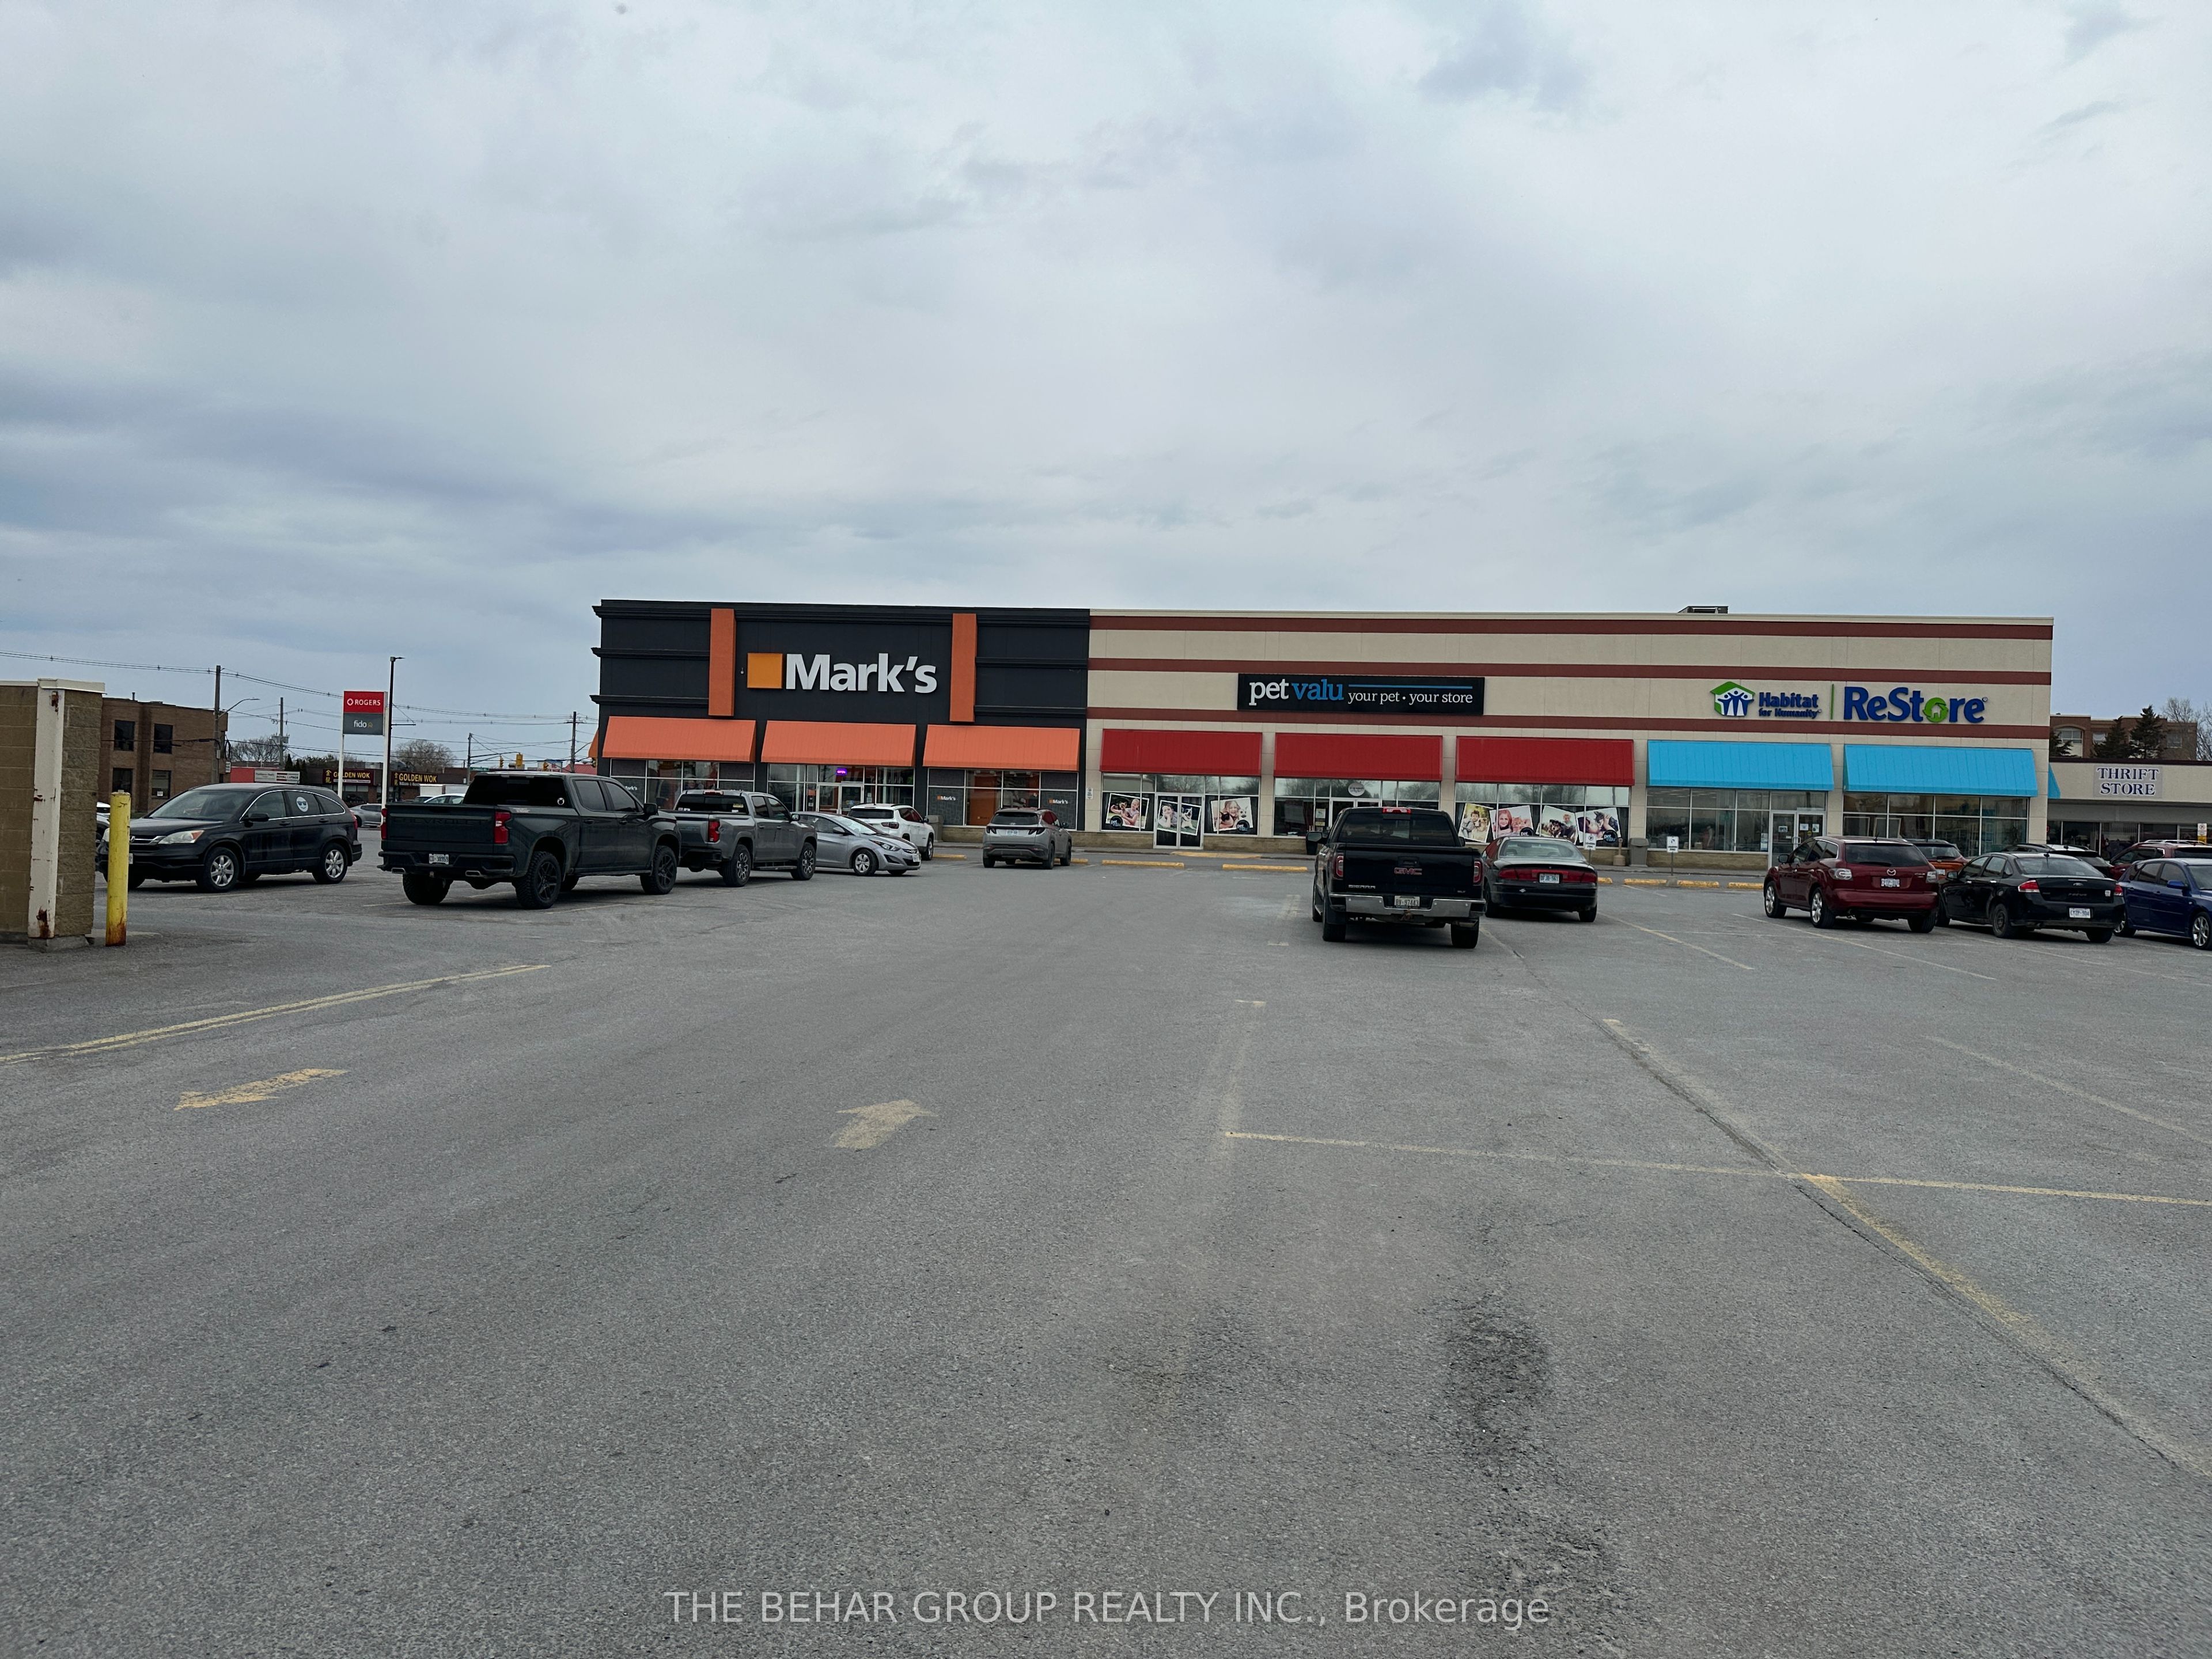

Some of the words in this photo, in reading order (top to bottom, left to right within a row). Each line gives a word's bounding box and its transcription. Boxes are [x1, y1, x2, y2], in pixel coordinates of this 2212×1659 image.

[786, 653, 938, 694] Mark's
[1249, 679, 1289, 706] pet
[1291, 679, 1344, 700] valu
[1347, 692, 1378, 704] your
[1379, 691, 1400, 704] pet
[1409, 693, 1440, 706] your
[1441, 692, 1474, 703] store
[1759, 692, 1819, 709] Habitat
[1843, 687, 1986, 724] ReStore
[1759, 708, 1772, 717] for
[399, 772, 423, 782] GOLDEN
[423, 774, 437, 783] WOK
[2097, 767, 2160, 780] THRIFT
[2100, 782, 2156, 795] STORE
[1394, 867, 1423, 875] GMC
